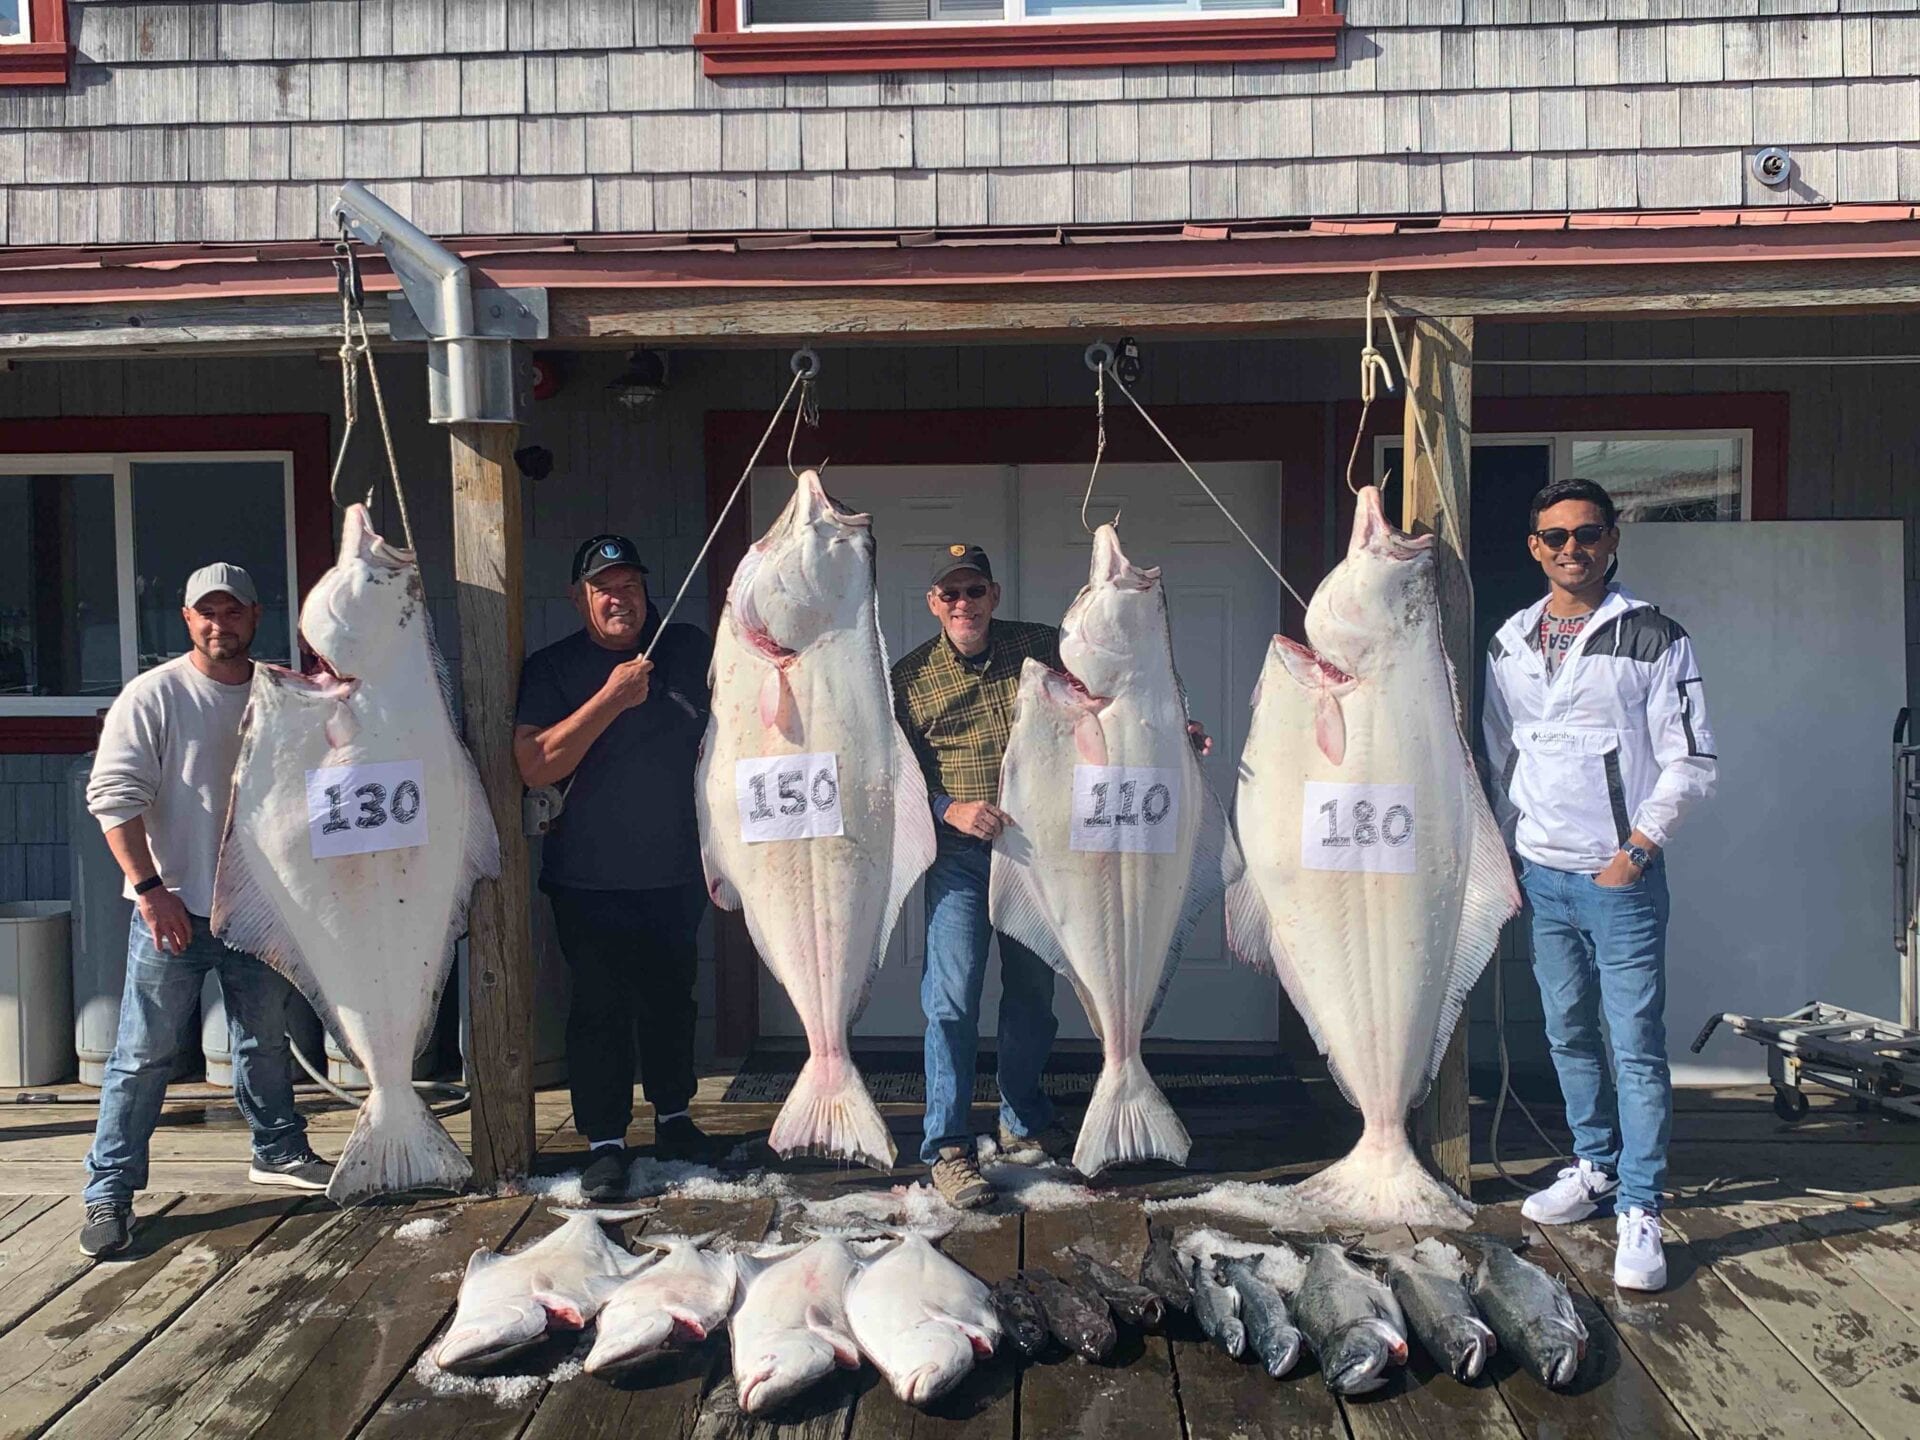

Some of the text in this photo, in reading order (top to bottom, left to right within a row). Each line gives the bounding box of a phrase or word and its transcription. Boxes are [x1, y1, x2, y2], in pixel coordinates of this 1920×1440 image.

[1558, 622, 1585, 634] USA
[322, 779, 420, 835] 130
[749, 768, 837, 823] 150
[1083, 780, 1171, 828] 110
[1320, 799, 1414, 848] 180
